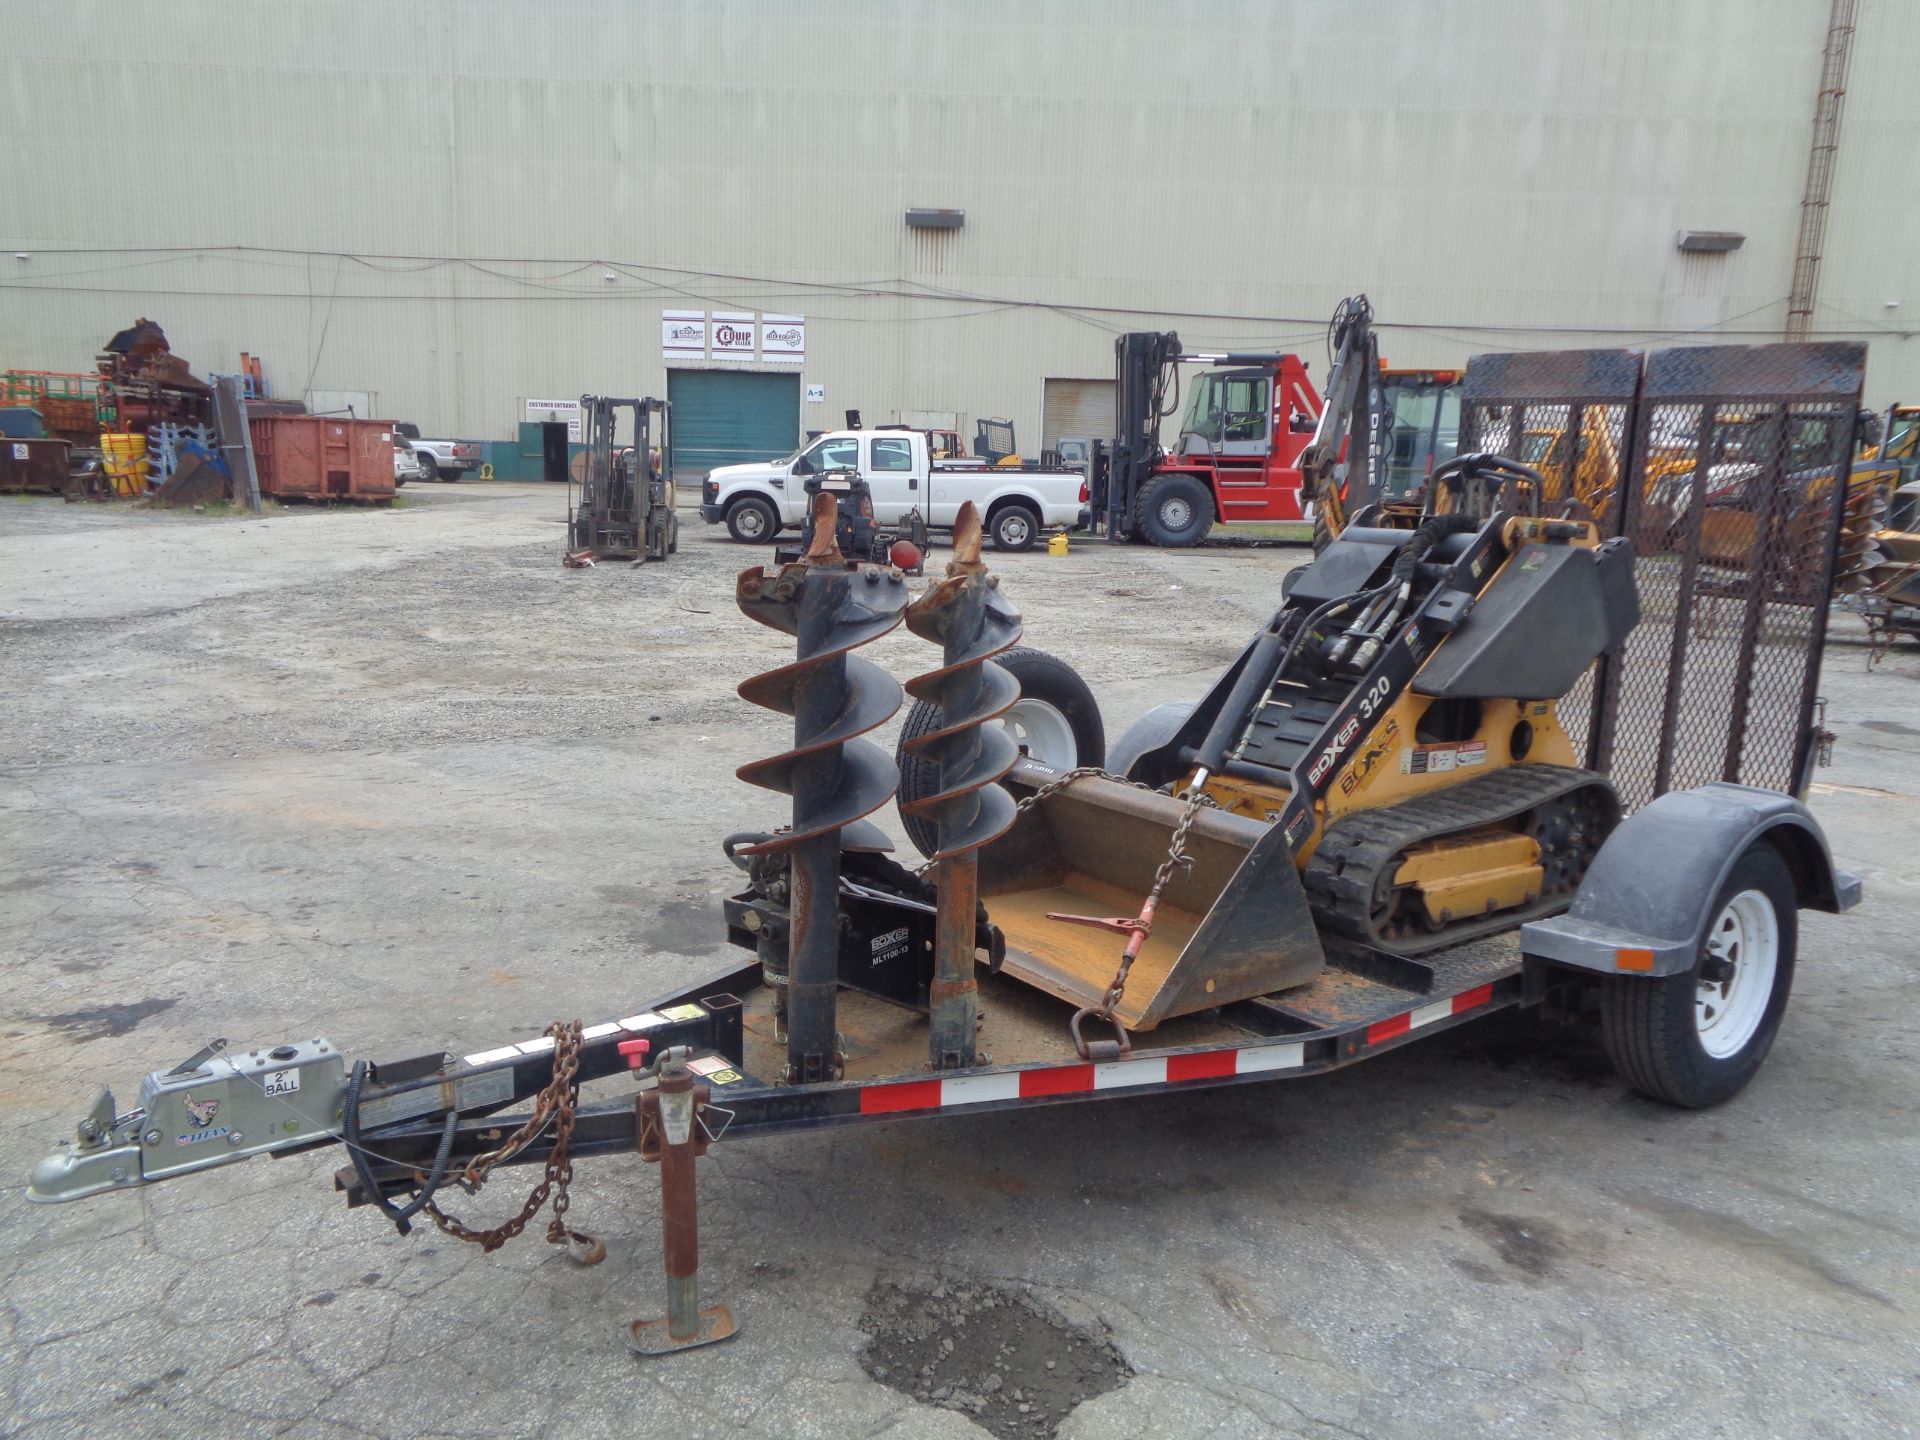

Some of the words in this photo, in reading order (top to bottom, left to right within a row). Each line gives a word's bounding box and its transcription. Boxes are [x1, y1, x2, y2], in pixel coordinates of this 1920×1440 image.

[723, 330, 751, 341] EQUIP
[807, 389, 824, 397] A-2
[1368, 413, 1379, 486] DEERE
[1359, 675, 1391, 719] 320
[1307, 716, 1360, 787] BOXER
[871, 928, 909, 951] BOXER
[266, 1079, 298, 1096] BALL
